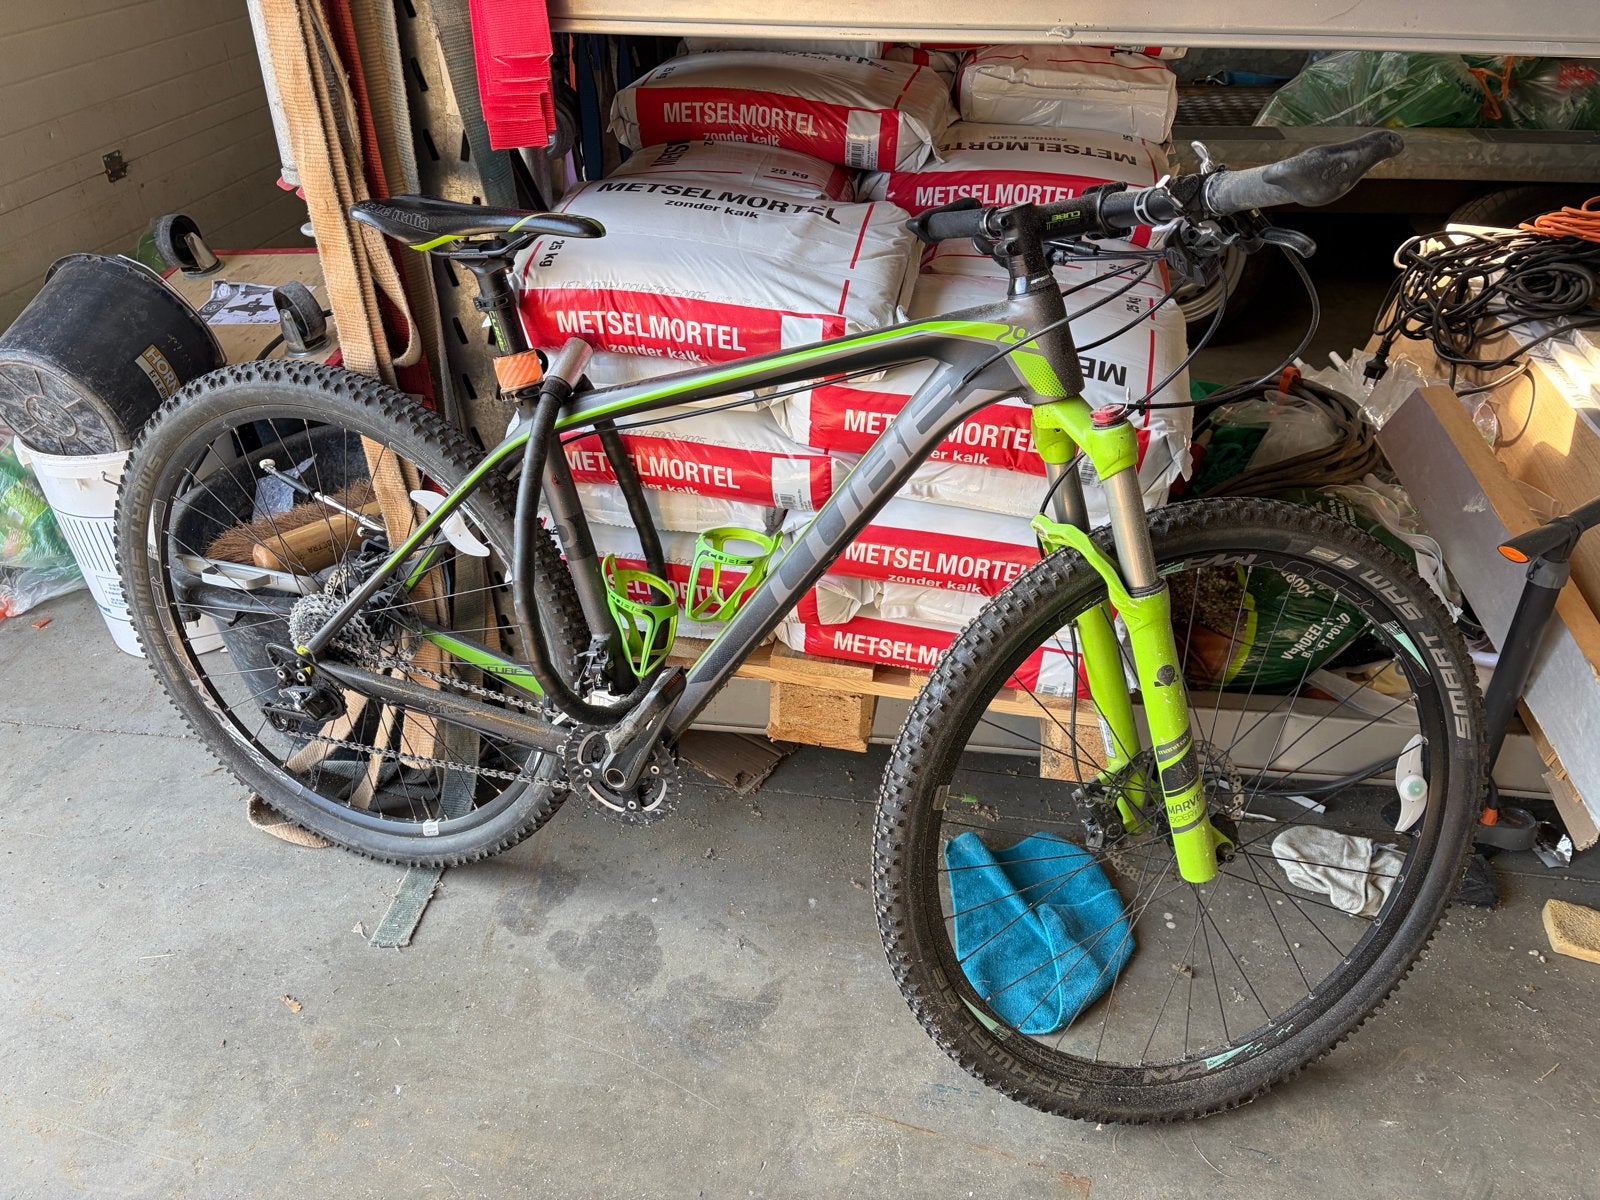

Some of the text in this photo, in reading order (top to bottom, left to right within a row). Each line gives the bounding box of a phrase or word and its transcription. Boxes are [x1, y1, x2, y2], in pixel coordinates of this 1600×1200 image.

[663, 101, 819, 137] METSELMORTEL
[703, 132, 748, 143] zonder
[751, 133, 781, 147] kalk
[938, 140, 1138, 166] METSELMORTE
[770, 167, 786, 176] 25
[597, 182, 841, 225] METSELMORTEL
[664, 199, 760, 220] zonder kalk
[539, 239, 565, 268] 25 kg
[556, 310, 747, 352] METSELMORTEL
[609, 344, 702, 362] zonder kalk
[844, 408, 1040, 453] METMORTEL
[564, 450, 741, 490] METELMORTEL
[953, 450, 990, 465] kalk
[888, 573, 982, 594] zonder kalk
[1359, 568, 1472, 740] SMART SAM
[1167, 791, 1203, 815] MARVE
